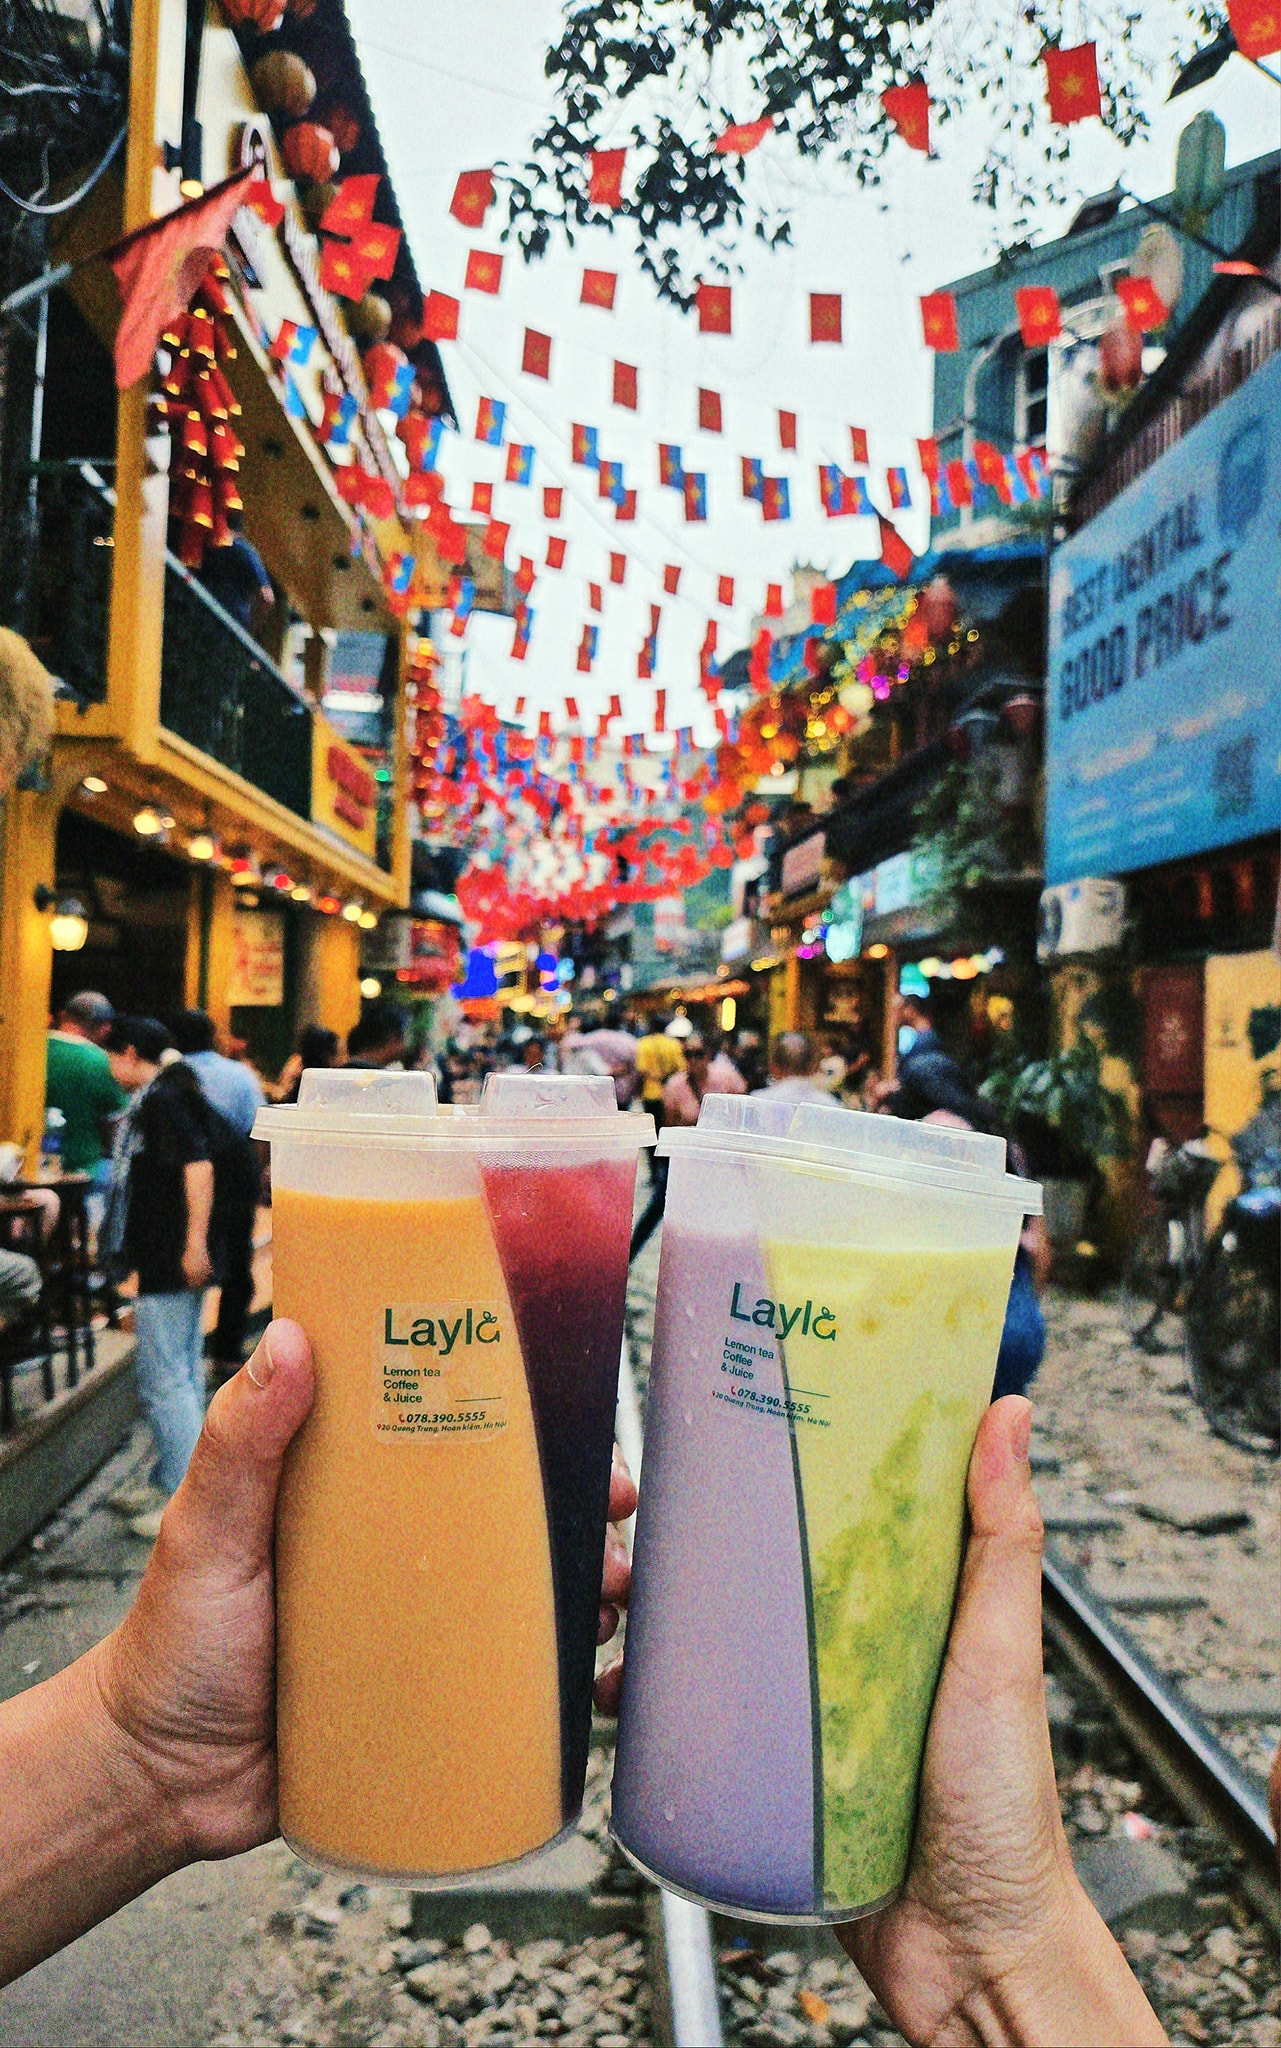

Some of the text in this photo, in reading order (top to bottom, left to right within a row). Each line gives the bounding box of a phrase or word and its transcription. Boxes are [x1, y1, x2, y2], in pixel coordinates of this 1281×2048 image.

[1060, 624, 1127, 722] GOOD
[1135, 550, 1233, 679] PRICE
[730, 1282, 836, 1341] Layla
[384, 1308, 500, 1356] Layla
[724, 1336, 774, 1359] Lemon tea
[722, 1350, 752, 1367] Coffee
[383, 1365, 441, 1377] Lemon tea
[720, 1362, 754, 1380] & Juice
[383, 1379, 419, 1390] Coffee
[383, 1392, 422, 1403] & Juice
[737, 1388, 811, 1414] 078.390.5555
[407, 1411, 486, 1423] 078.390.5555
